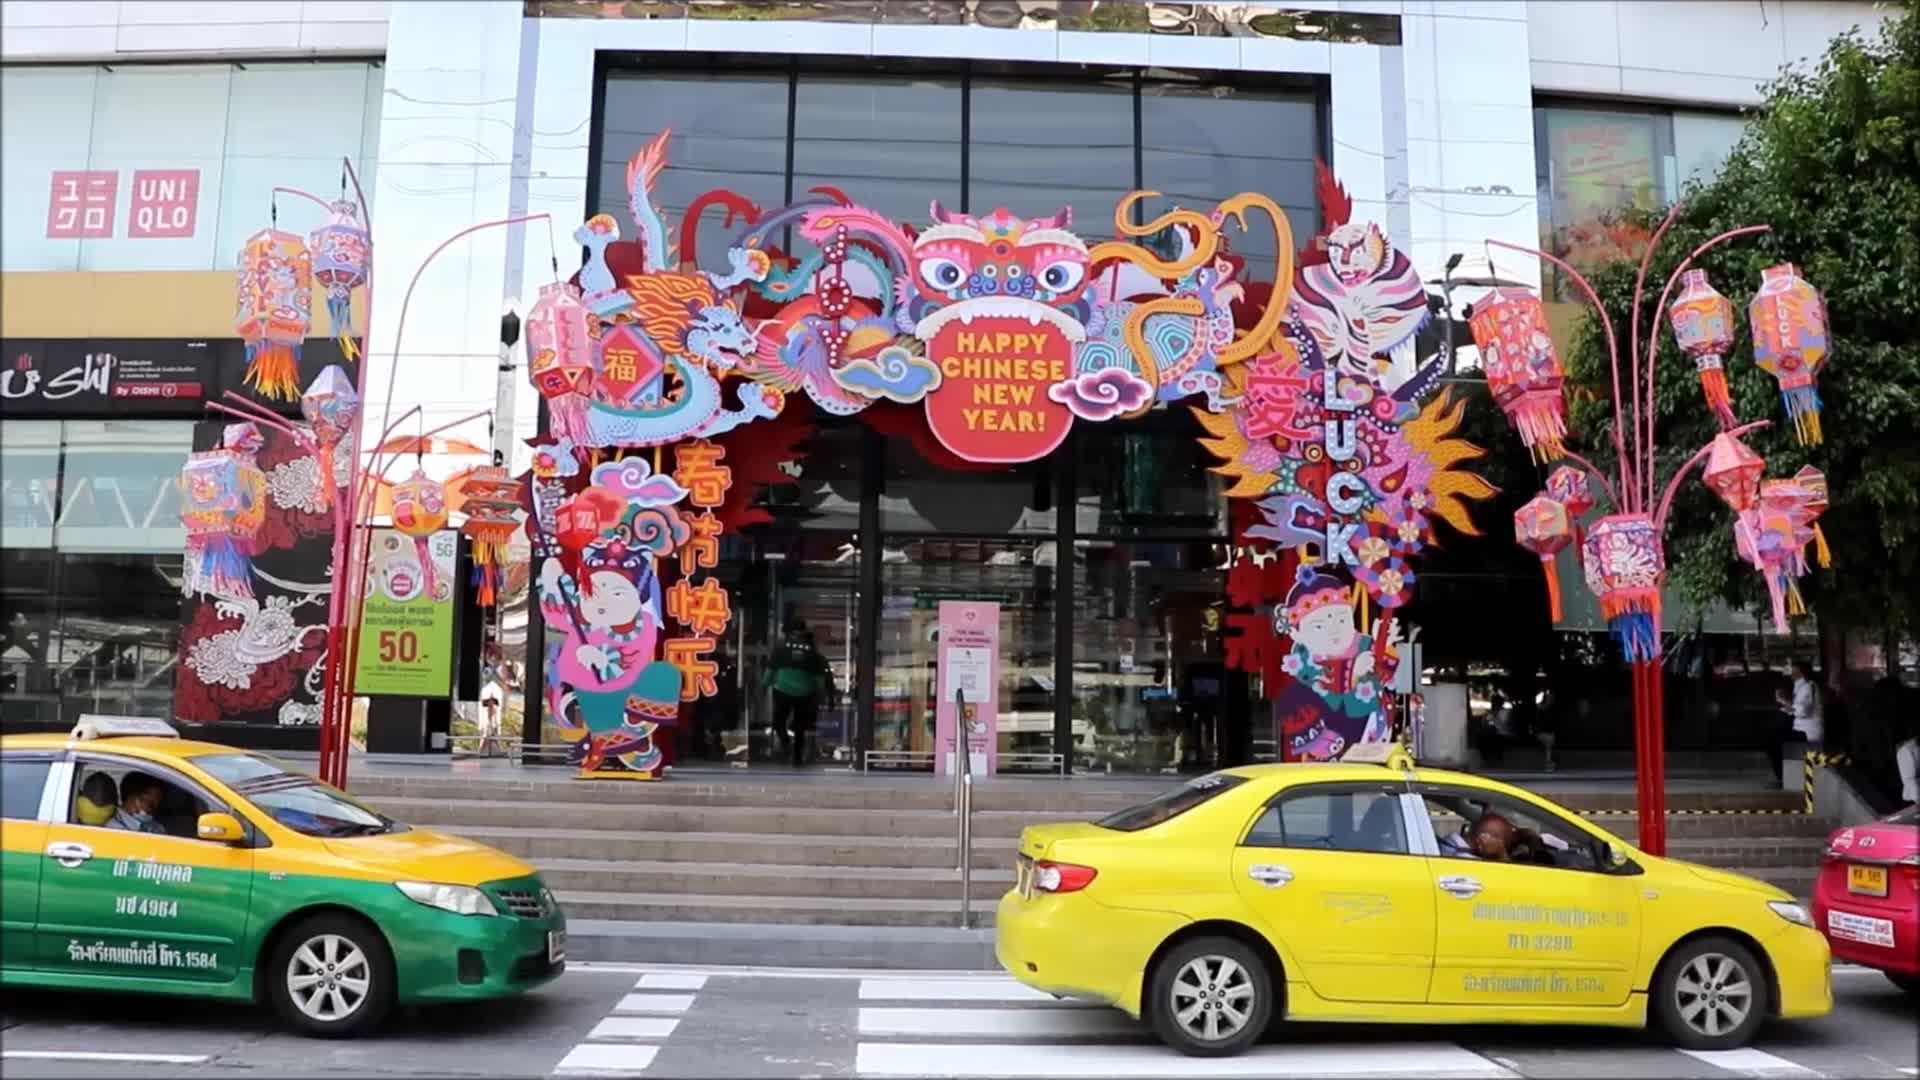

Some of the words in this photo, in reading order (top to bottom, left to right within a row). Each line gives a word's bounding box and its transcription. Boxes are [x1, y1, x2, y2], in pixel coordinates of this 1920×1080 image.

[957, 331, 1048, 354] HAPPY
[604, 347, 639, 383] 福
[941, 356, 1066, 380] CHINESE
[973, 383, 1036, 405] NEW
[962, 408, 1046, 432] YEAR!
[1323, 370, 1367, 566] LUCK
[435, 542, 453, 558] 5G
[665, 440, 732, 701] 春节快乐
